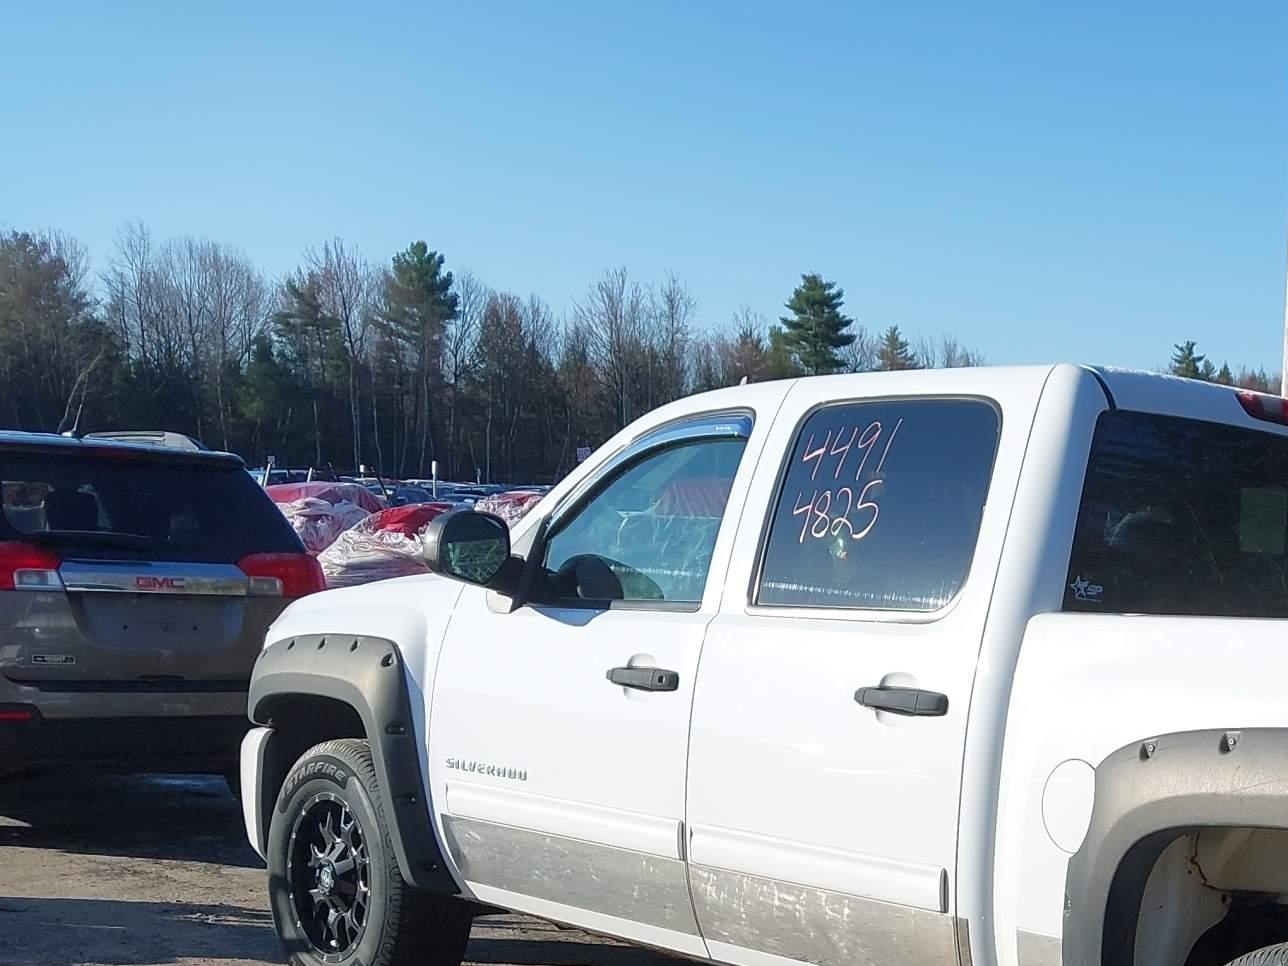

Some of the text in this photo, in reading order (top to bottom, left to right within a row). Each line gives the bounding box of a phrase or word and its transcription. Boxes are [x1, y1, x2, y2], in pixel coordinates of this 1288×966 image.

[802, 418, 903, 481] 4491
[793, 480, 883, 543] 4825
[136, 576, 185, 588] GMC
[286, 761, 346, 795] STARFIRE
[445, 757, 528, 781] SILVERADO
